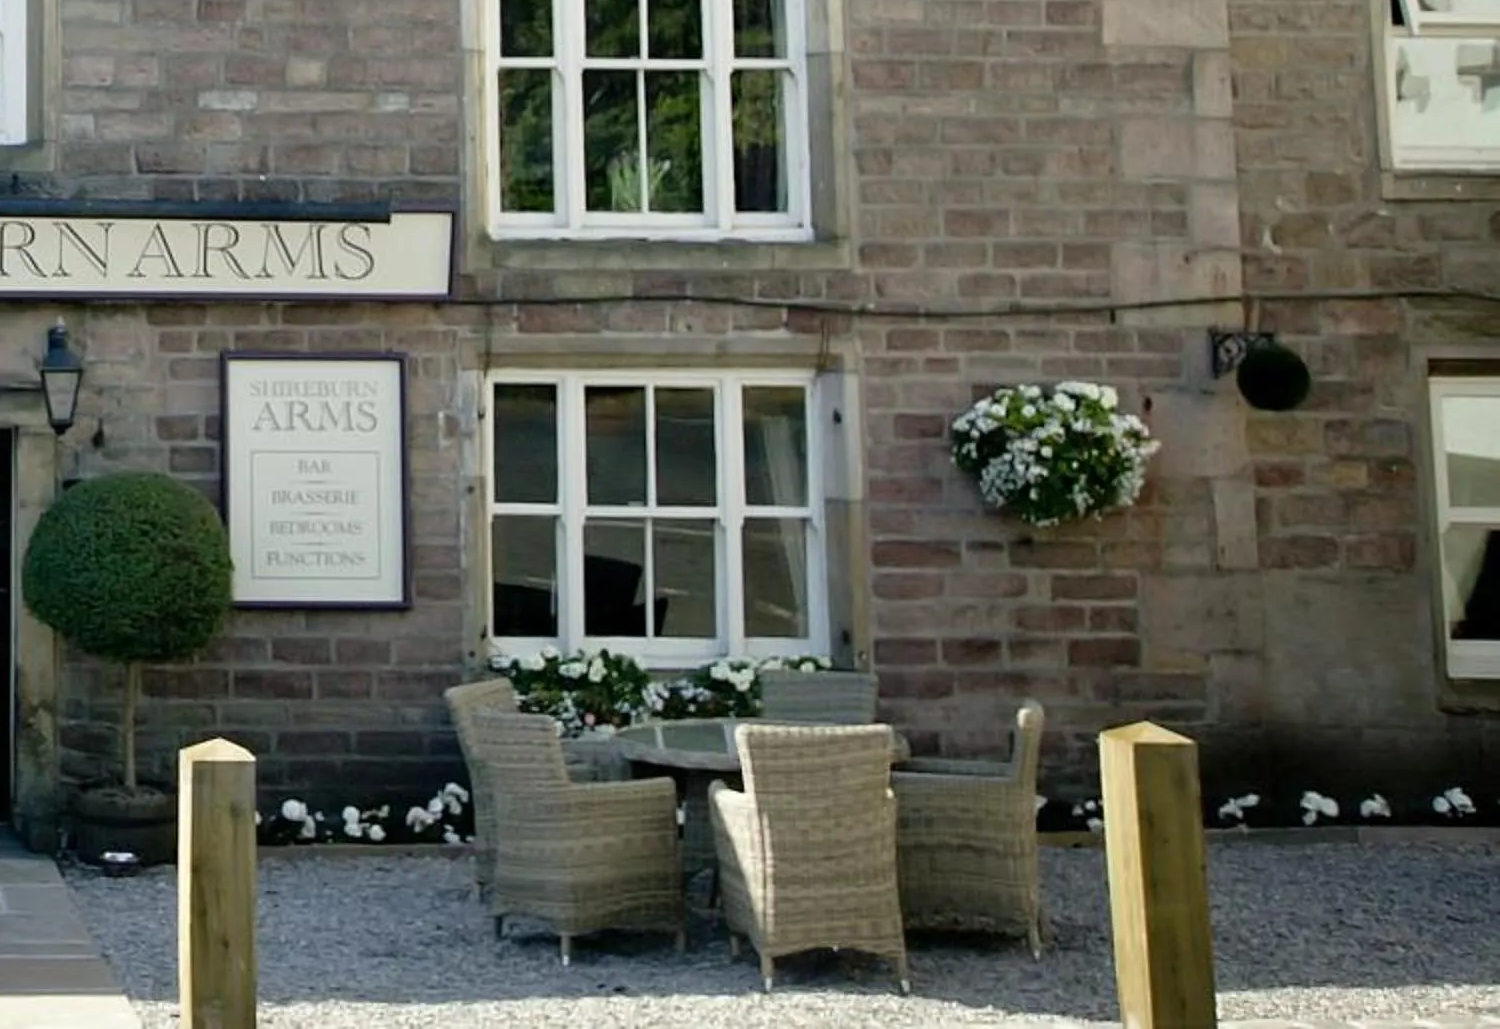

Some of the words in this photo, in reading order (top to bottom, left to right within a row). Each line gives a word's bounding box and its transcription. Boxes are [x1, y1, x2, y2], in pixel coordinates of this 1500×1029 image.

[126, 221, 376, 280] ARMS
[252, 399, 378, 434] ARMS
[297, 458, 332, 474] BAR
[266, 551, 367, 567] FUNCTIONS
